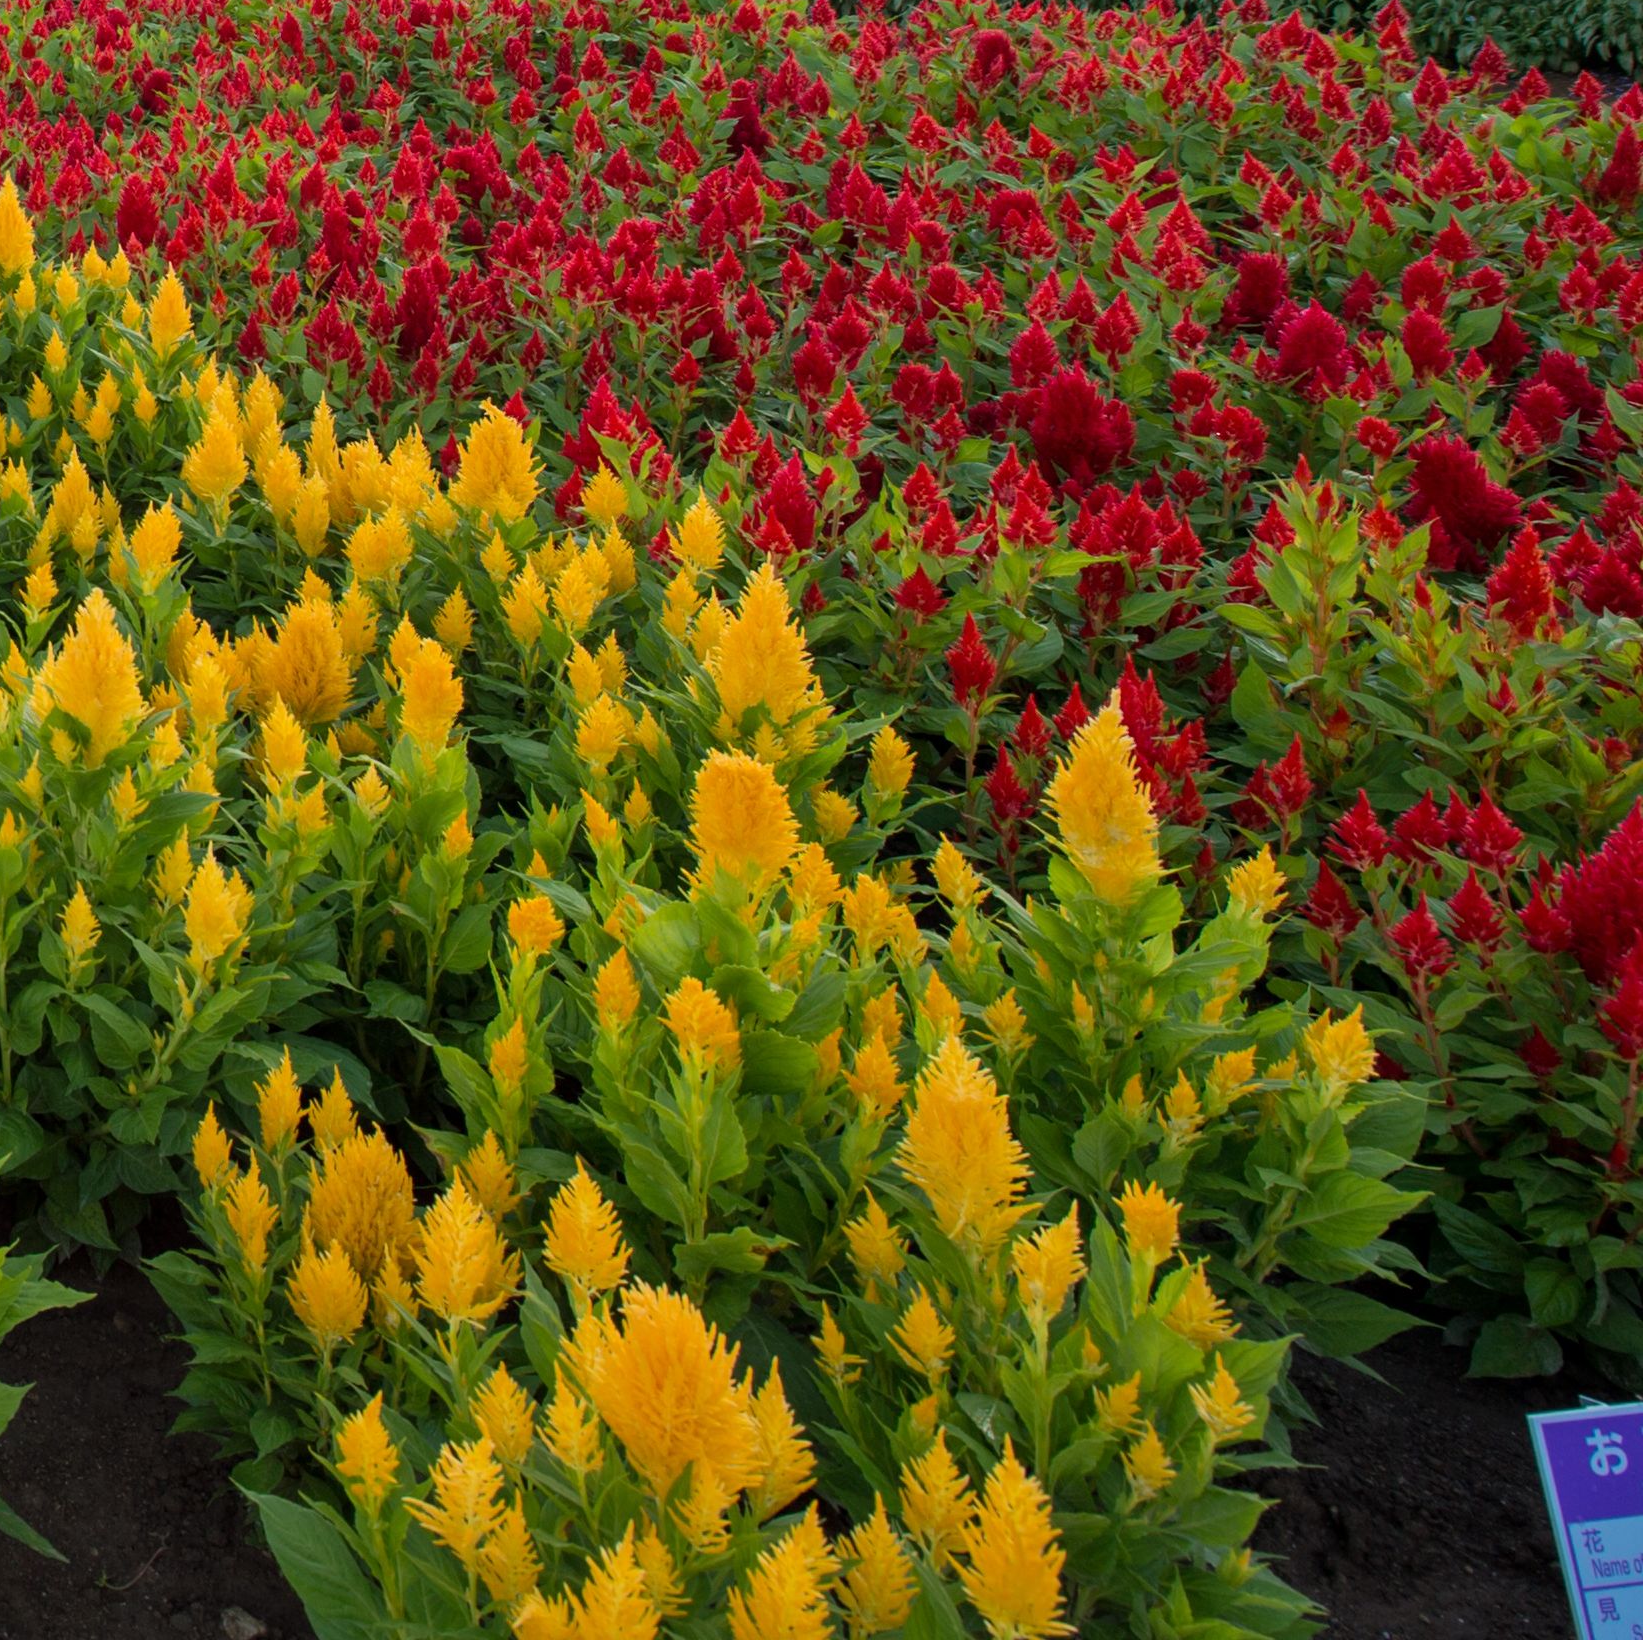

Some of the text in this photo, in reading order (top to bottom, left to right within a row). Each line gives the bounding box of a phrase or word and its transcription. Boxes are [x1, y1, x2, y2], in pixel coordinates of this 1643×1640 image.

[1585, 1427, 1643, 1476] お
[1580, 1528, 1604, 1555] 花
[1591, 1558, 1631, 1579] Name
[1599, 1597, 1621, 1622] 見
[1632, 1623, 1643, 1640] S
